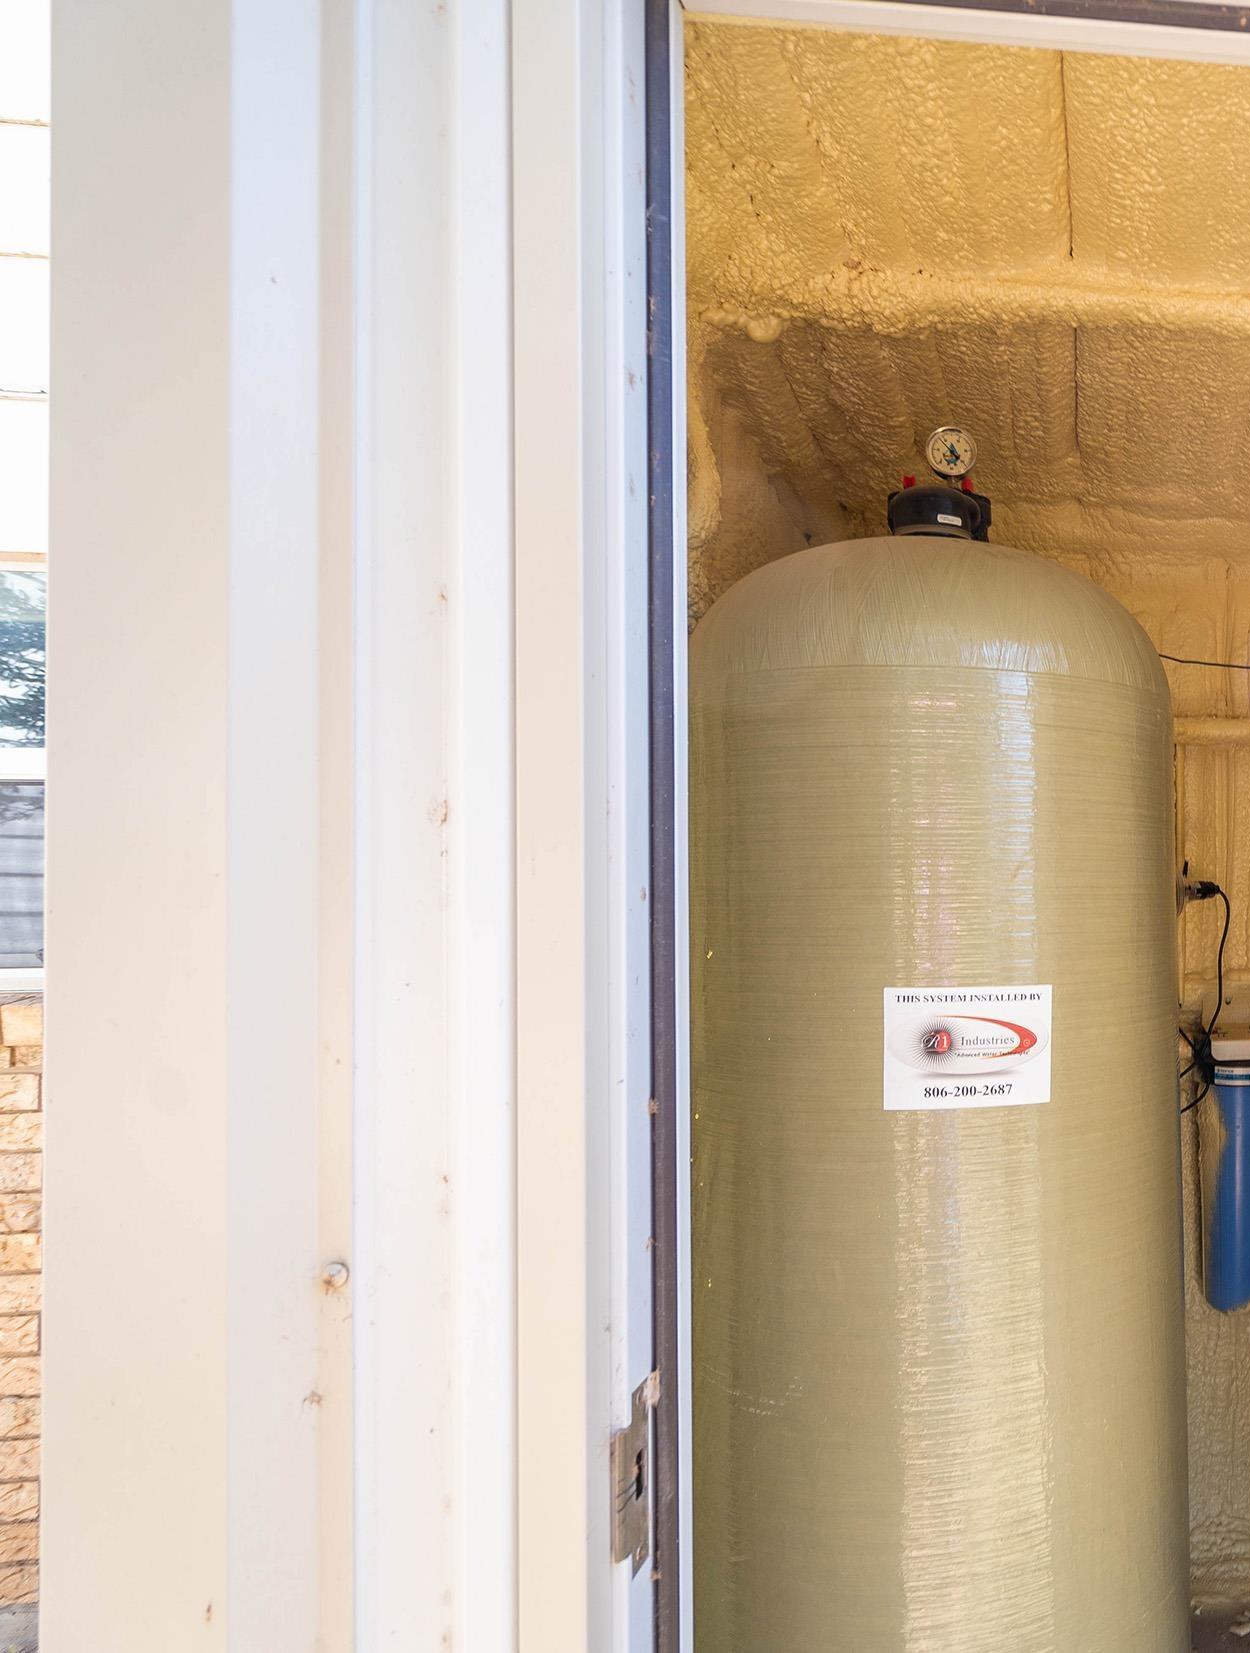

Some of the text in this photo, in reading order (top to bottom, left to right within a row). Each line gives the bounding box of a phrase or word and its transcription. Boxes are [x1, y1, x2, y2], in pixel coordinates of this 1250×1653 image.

[895, 993, 1042, 1003] THIS SYSTEM INSTALLED BY
[961, 1036, 1015, 1046] Industries
[923, 1084, 1013, 1098] 806-200-2687
